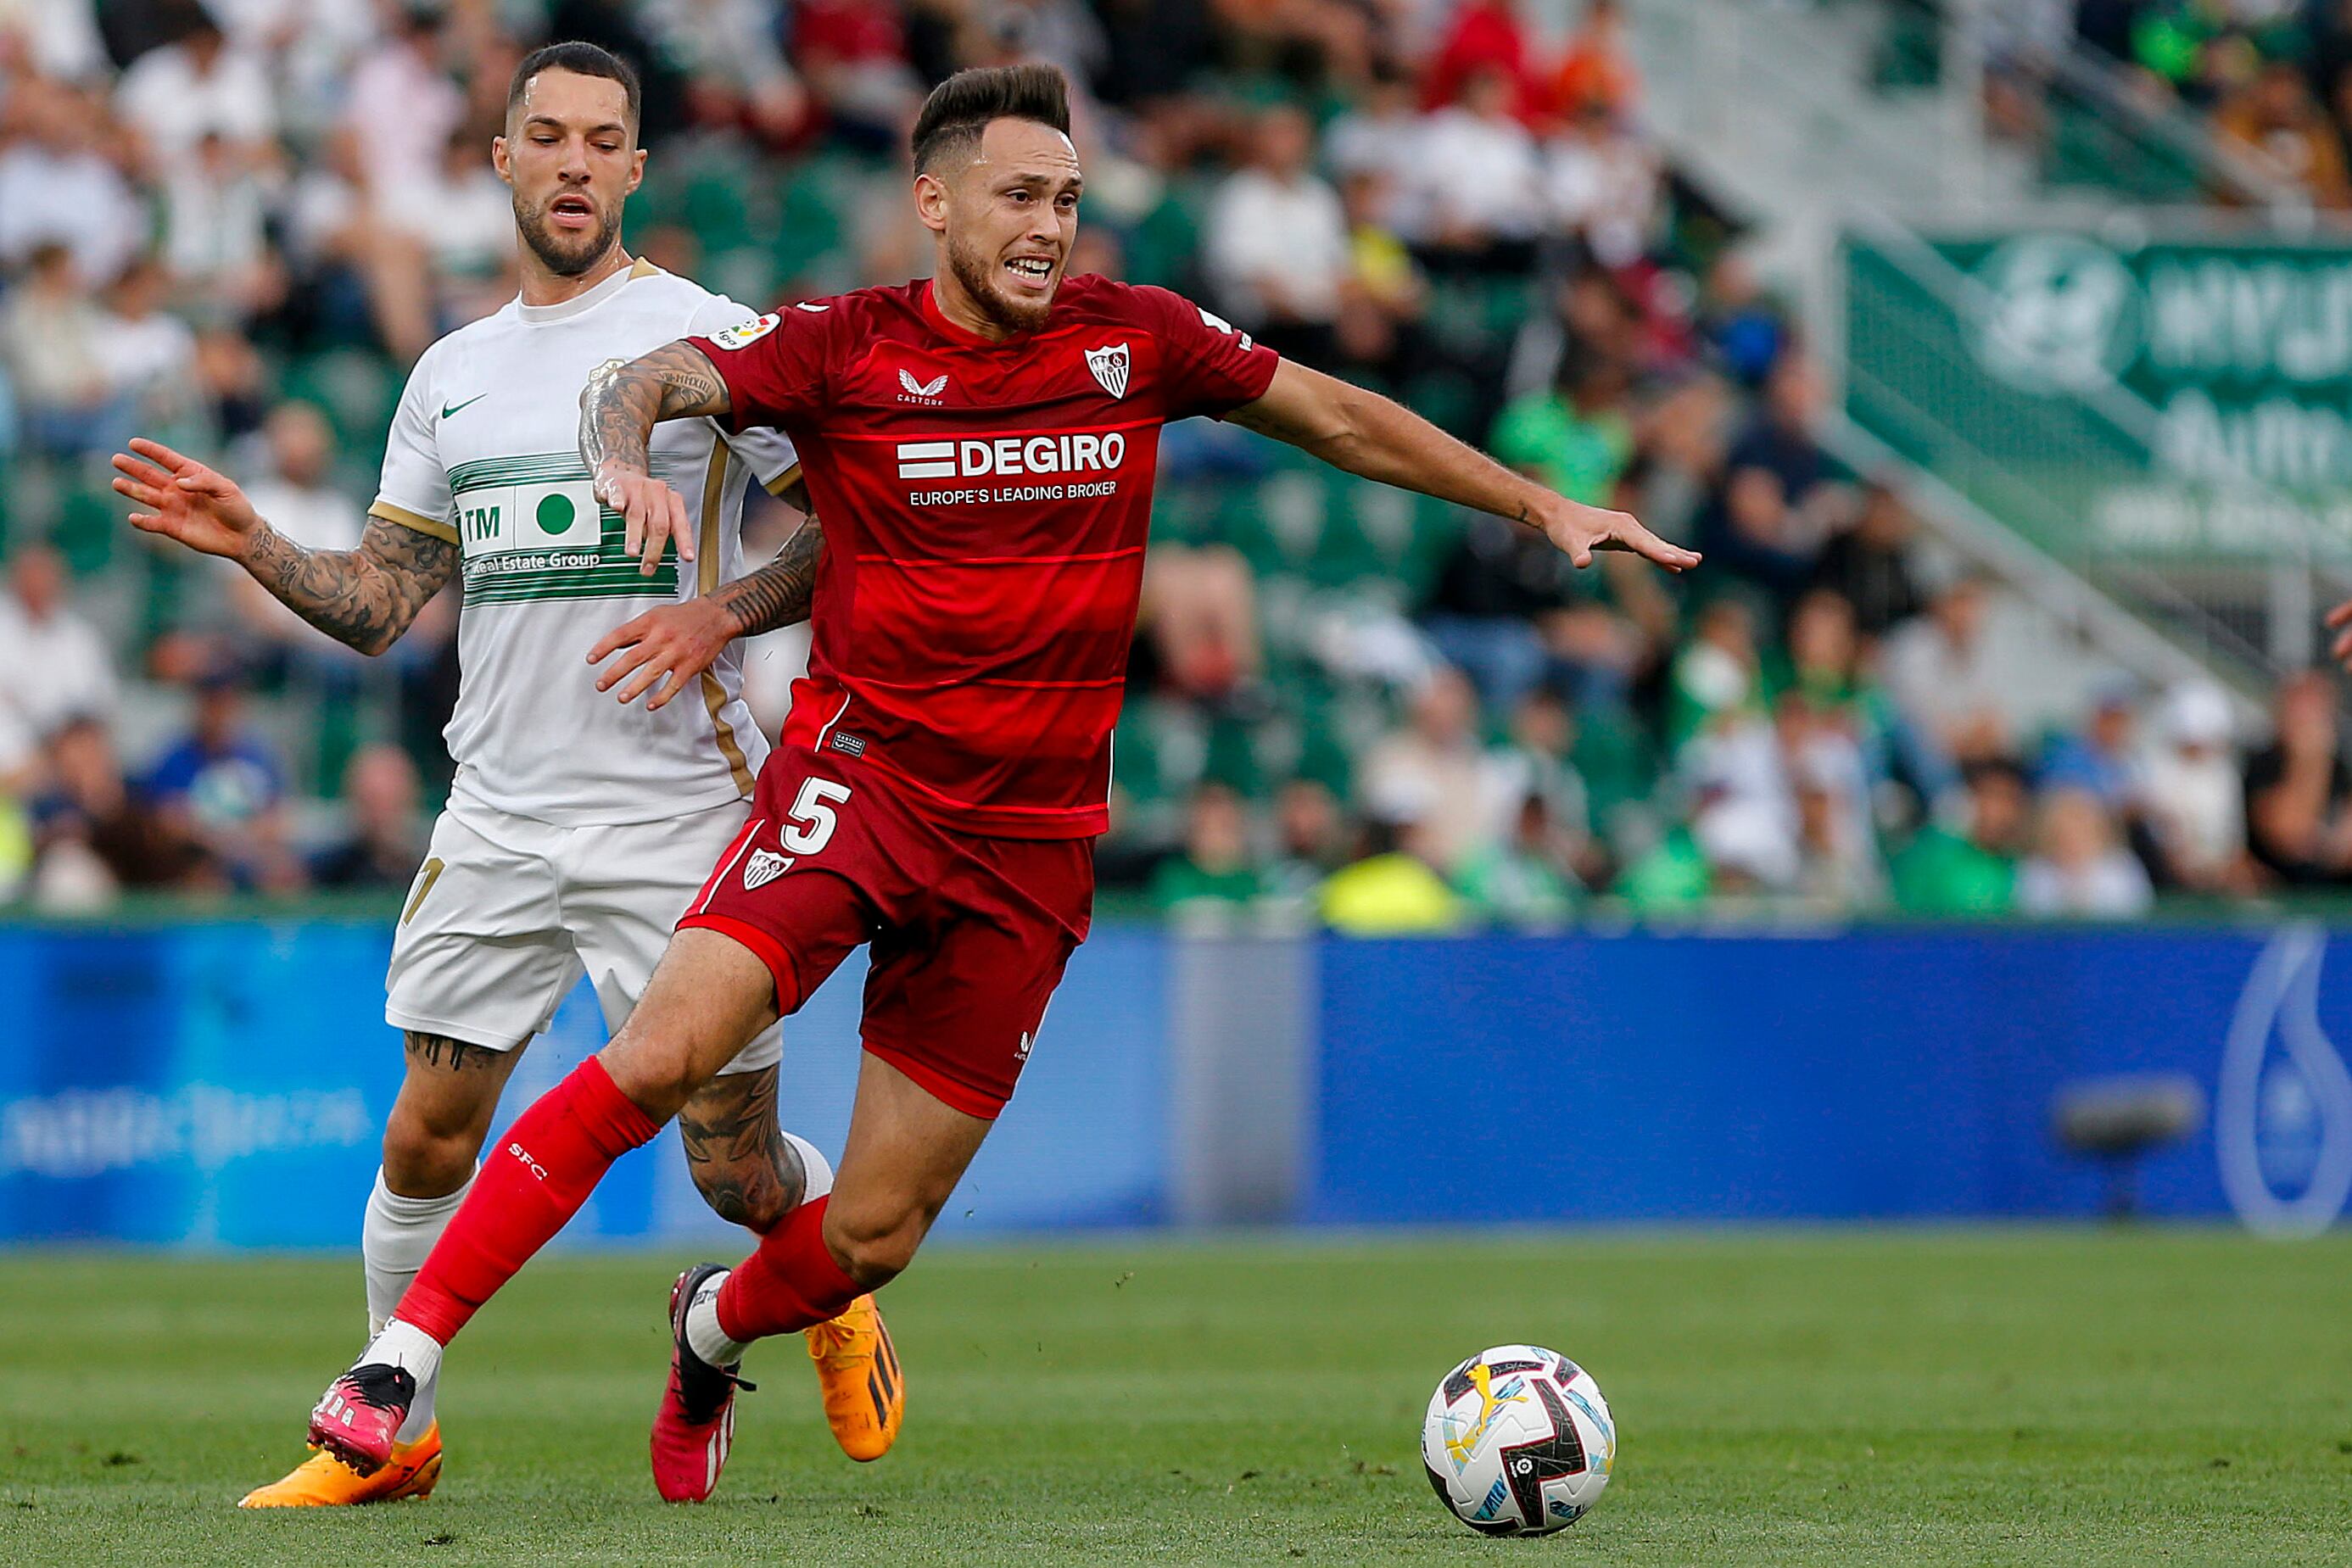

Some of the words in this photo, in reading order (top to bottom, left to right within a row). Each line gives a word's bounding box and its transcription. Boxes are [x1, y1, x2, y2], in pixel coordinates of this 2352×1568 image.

[897, 393, 943, 405] CASTORE
[960, 433, 1125, 476] DEGIRO
[993, 485, 1063, 502] LEADING
[1067, 481, 1117, 499] BROKER
[465, 505, 500, 543] TM
[502, 554, 545, 570] Estate
[549, 552, 601, 568] Group
[779, 776, 852, 856] 5
[508, 1142, 548, 1181] SFC
